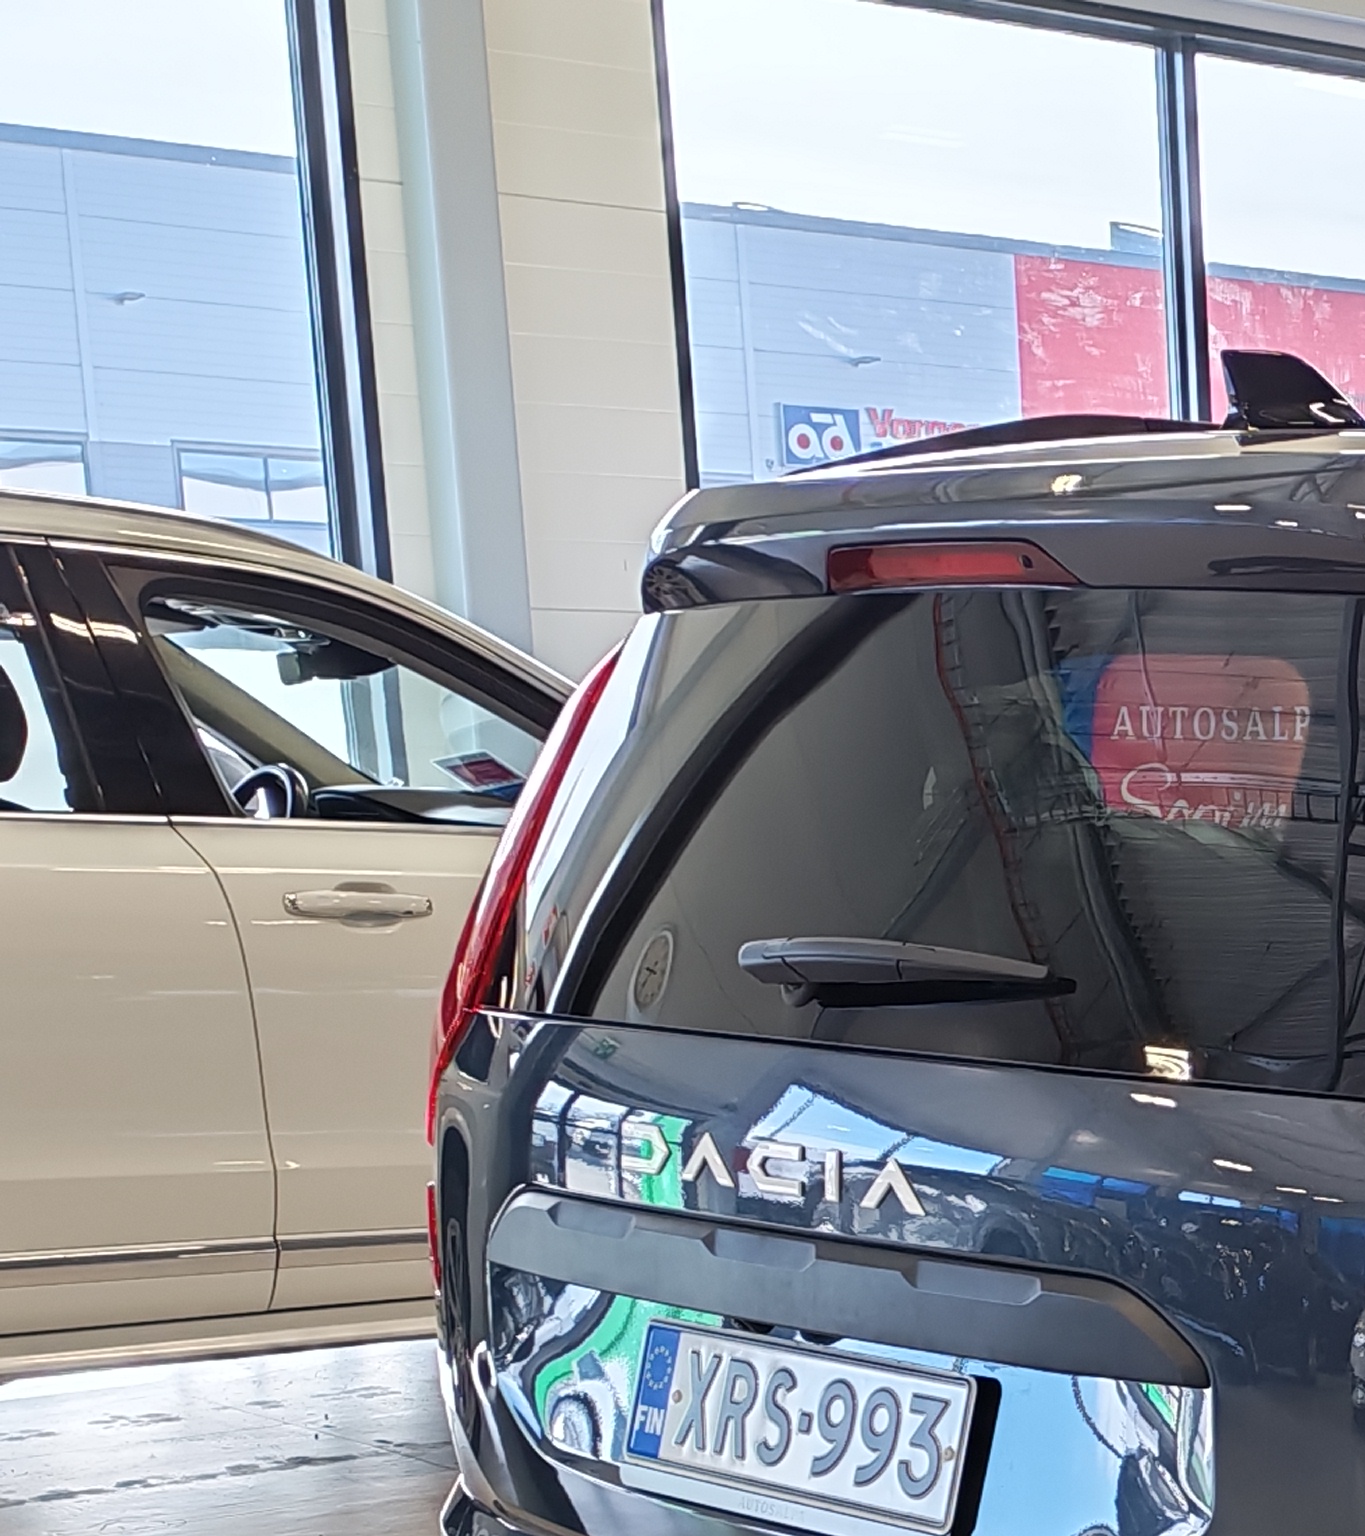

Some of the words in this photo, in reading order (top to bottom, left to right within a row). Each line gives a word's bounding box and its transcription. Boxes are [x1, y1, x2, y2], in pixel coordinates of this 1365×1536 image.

[620, 1121, 927, 1217] DACIA
[634, 1405, 666, 1437] FIN
[674, 1348, 952, 1500] XRS-993
